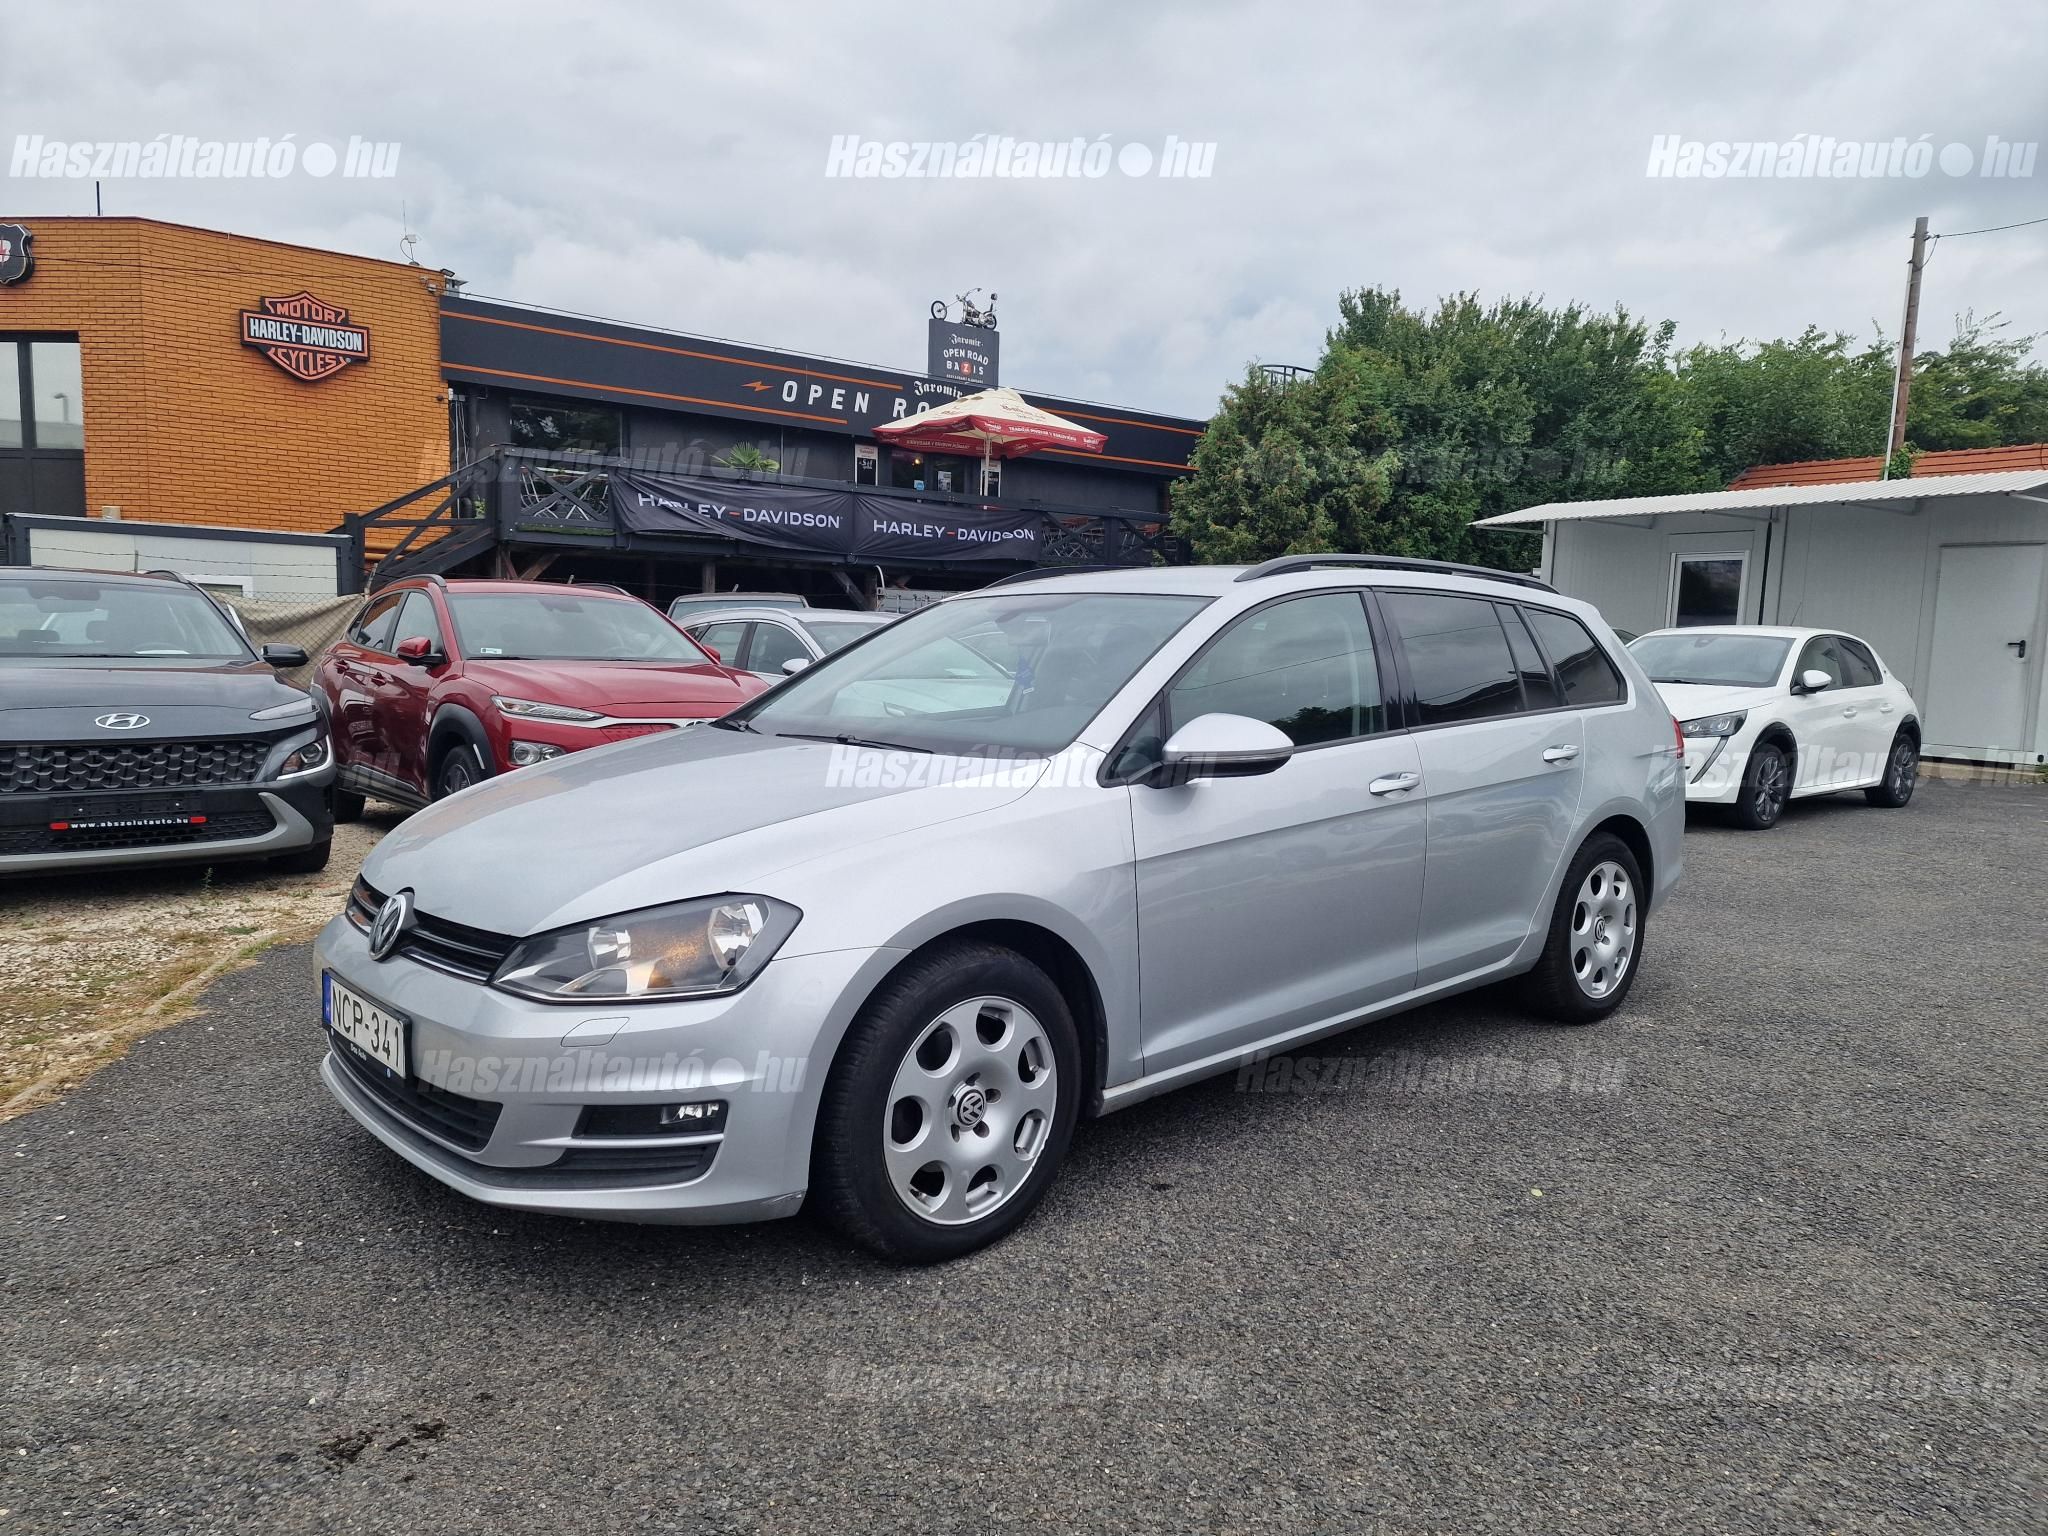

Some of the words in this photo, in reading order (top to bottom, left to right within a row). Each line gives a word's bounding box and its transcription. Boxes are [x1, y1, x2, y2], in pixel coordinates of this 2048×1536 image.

[276, 300, 336, 323] MOTOR
[249, 317, 363, 352] HARLEY-DAVIDSON
[277, 348, 338, 376] CYCLES
[943, 348, 966, 358] OPEN
[967, 350, 989, 366] ROAD
[946, 360, 984, 376] BAZIS
[782, 380, 870, 414] OPEN
[892, 397, 931, 419] RO
[71, 818, 189, 829] www.abszolutauto.hu
[332, 985, 399, 1068] NCP-341
